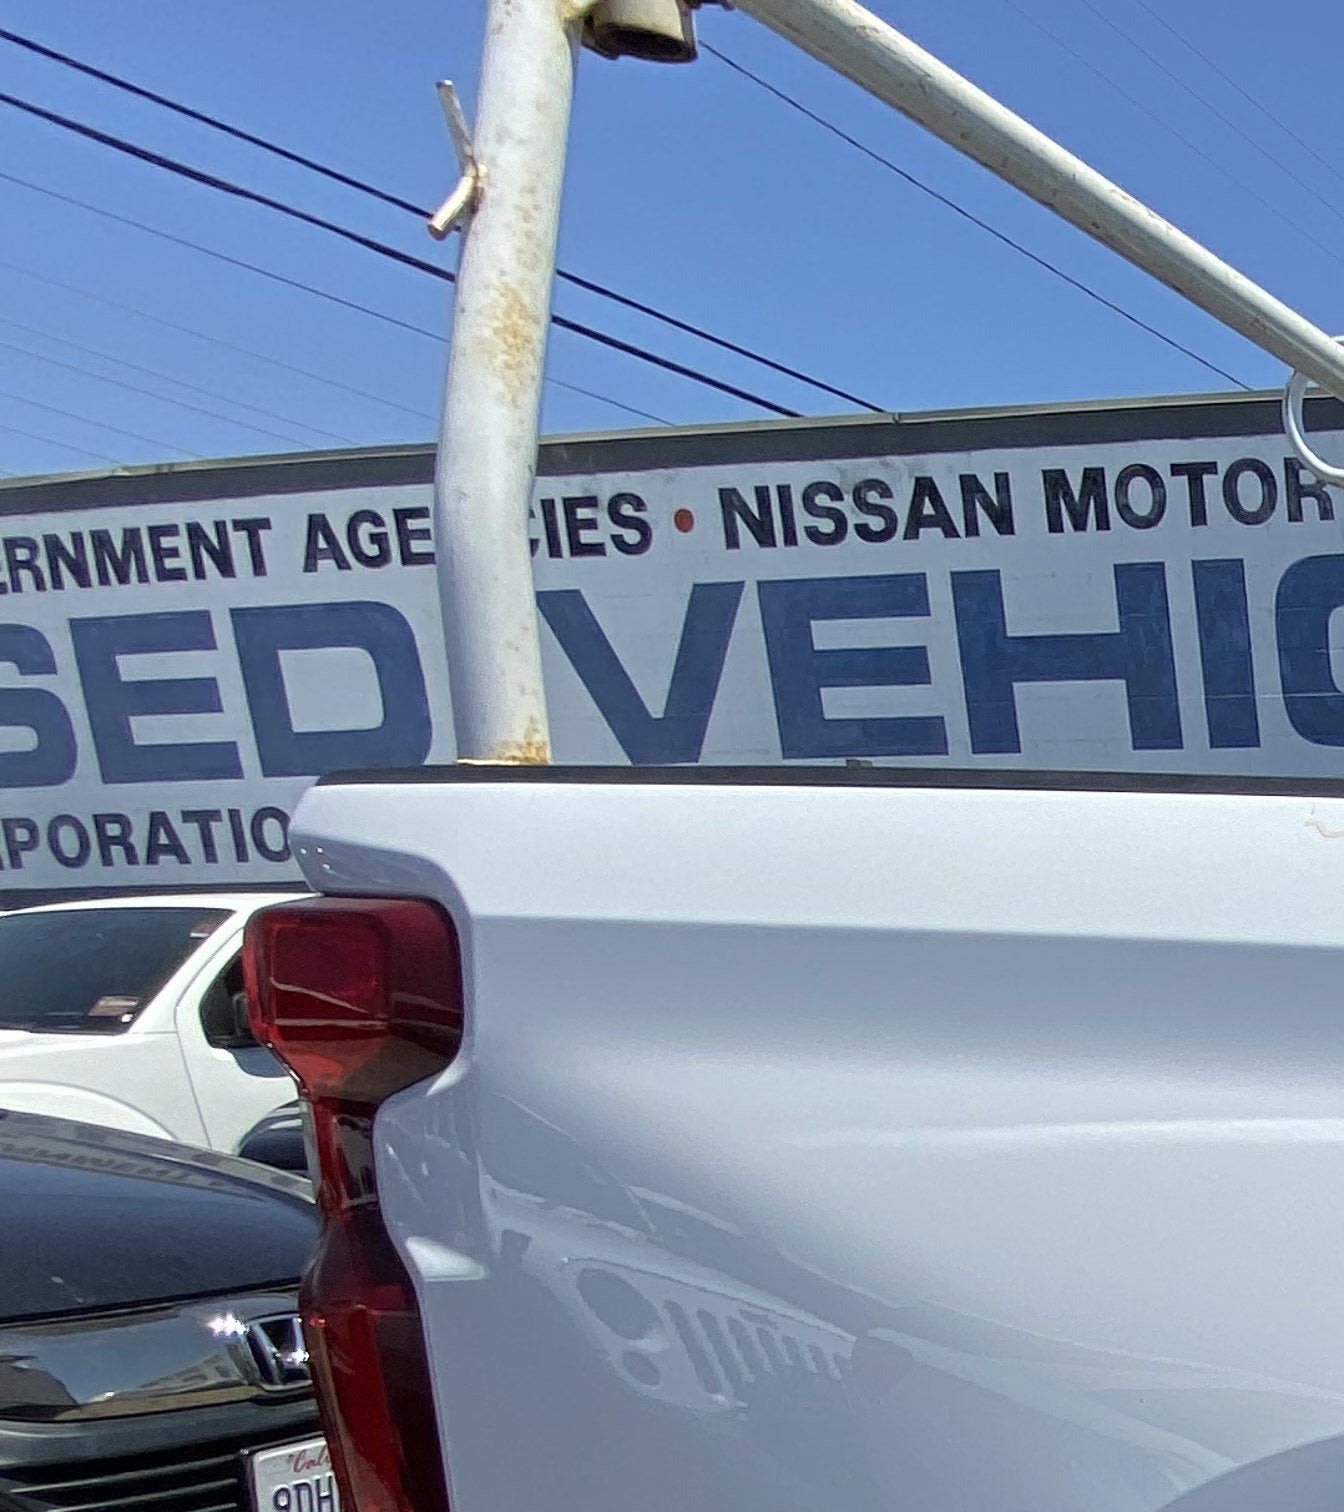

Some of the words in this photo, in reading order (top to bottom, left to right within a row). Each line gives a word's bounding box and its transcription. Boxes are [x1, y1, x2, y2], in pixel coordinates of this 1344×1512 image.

[0, 518, 273, 594] RNMENT
[302, 491, 653, 572] AGEIES
[718, 471, 1015, 551] NISSAN
[1042, 457, 1335, 535] MOTOR
[0, 806, 290, 872] PORATIO
